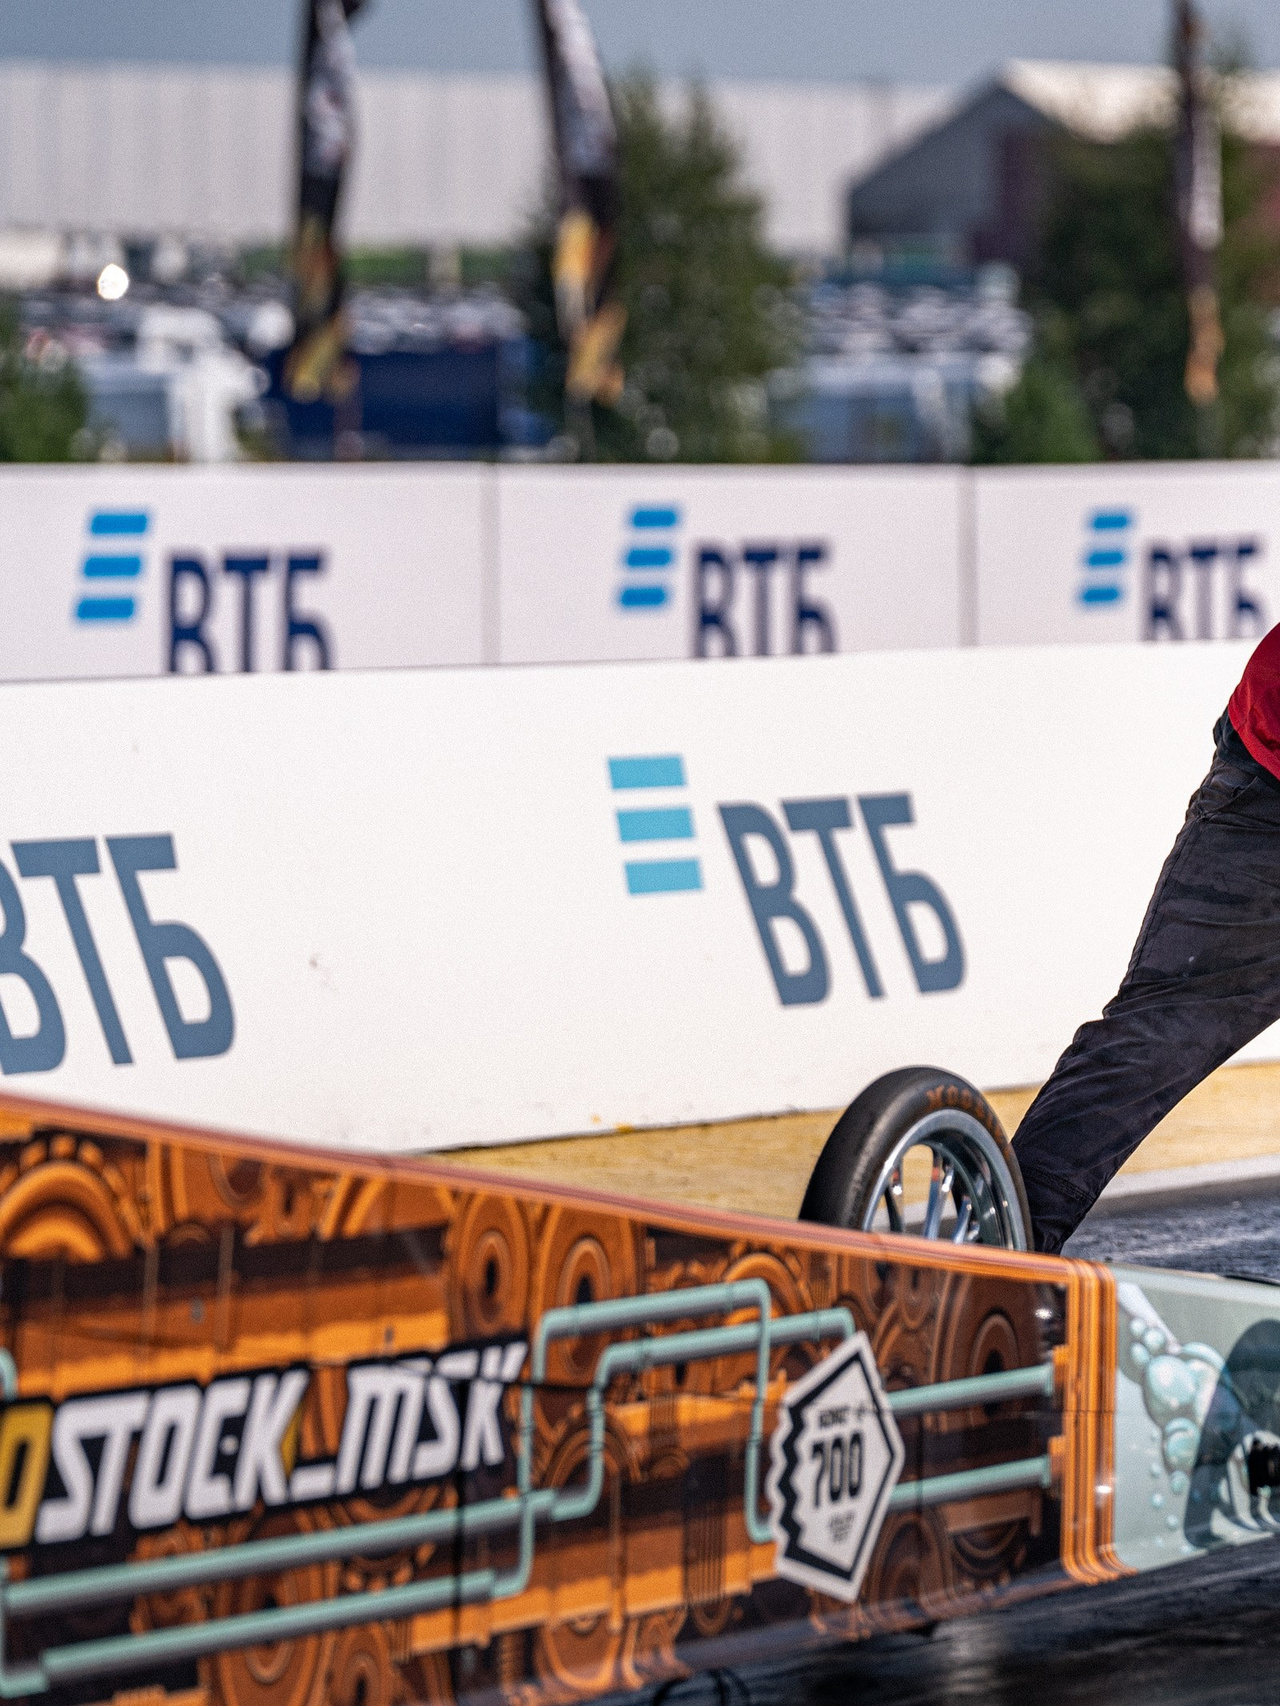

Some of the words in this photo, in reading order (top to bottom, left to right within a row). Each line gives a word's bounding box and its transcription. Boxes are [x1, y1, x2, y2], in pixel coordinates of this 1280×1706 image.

[166, 546, 334, 674] ВТБ
[693, 538, 836, 660] ВТБ
[1144, 536, 1266, 643] ВТБ
[0, 833, 236, 1076] ВТБ
[716, 791, 968, 1008] ВТБ
[812, 1433, 865, 1509] 700
